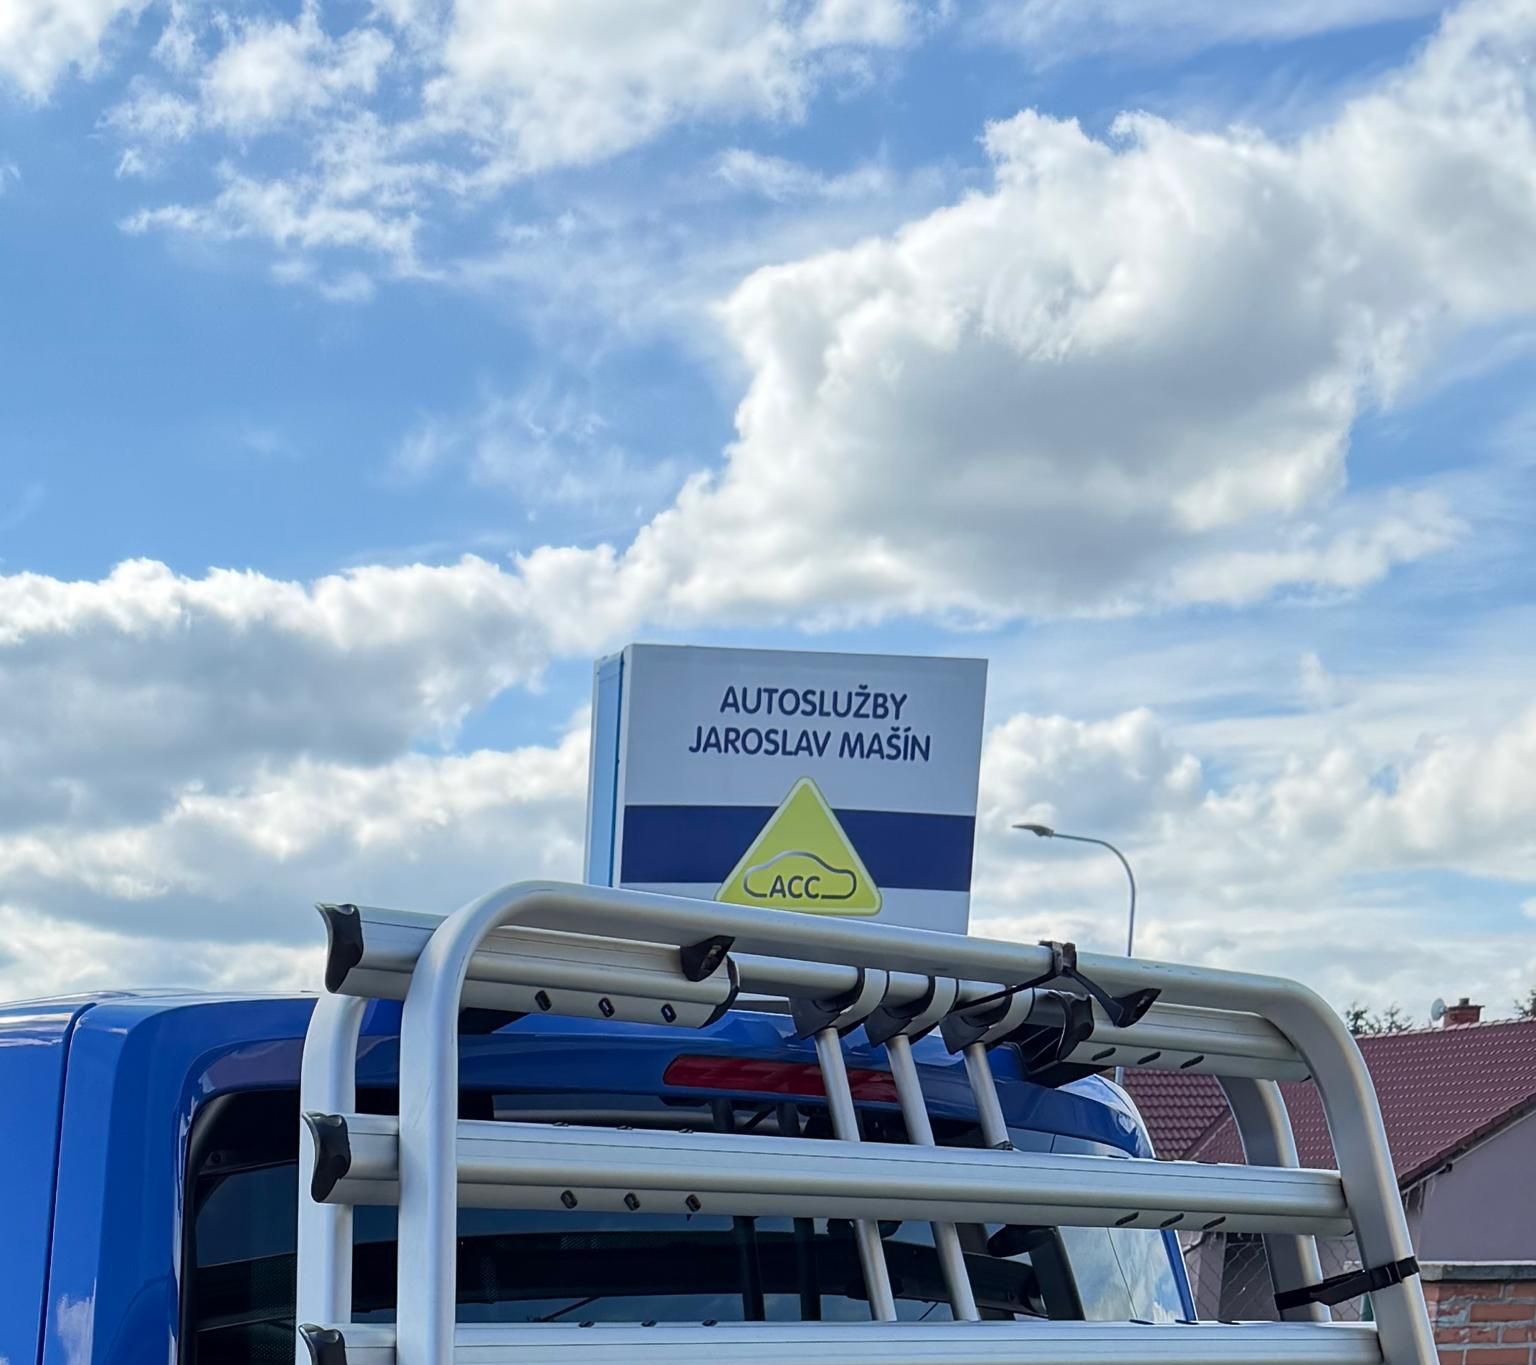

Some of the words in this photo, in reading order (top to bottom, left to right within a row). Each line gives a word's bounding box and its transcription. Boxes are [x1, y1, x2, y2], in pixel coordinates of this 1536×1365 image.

[720, 684, 907, 721] AUTOSLUŽBY
[689, 726, 831, 758] JAROSLAV
[839, 727, 931, 762] MAŠÍN
[769, 875, 820, 899] ACC
